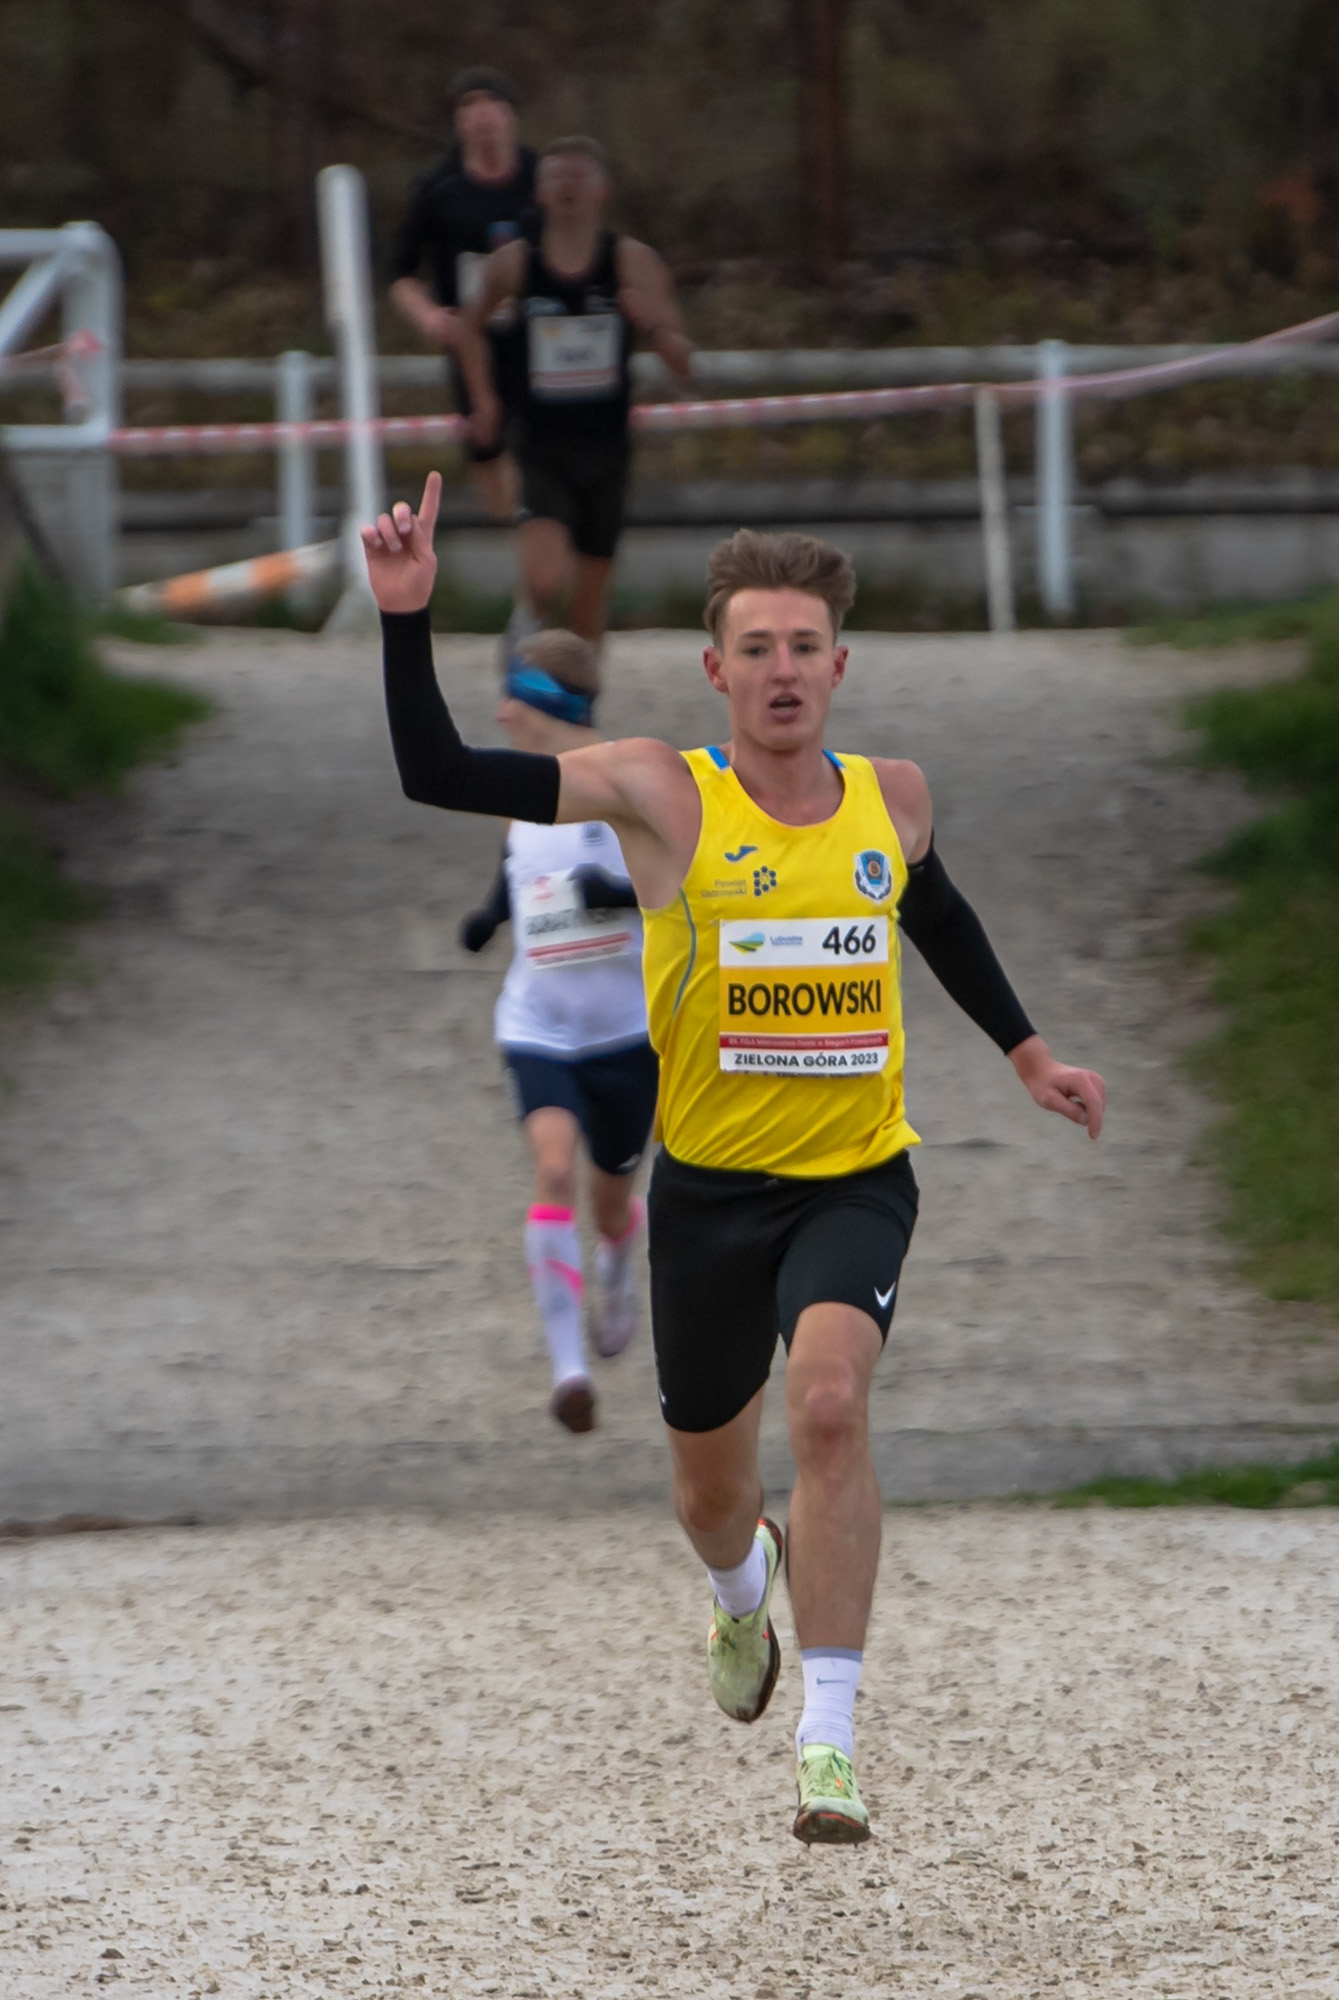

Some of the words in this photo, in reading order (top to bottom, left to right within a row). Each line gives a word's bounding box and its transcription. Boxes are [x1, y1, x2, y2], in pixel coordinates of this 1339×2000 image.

[822, 924, 876, 955] 466
[728, 978, 882, 1016] BOROWSKI
[734, 1052, 800, 1067] ZIELONA
[802, 1051, 848, 1067] GÓRA
[850, 1052, 878, 1066] 2023
